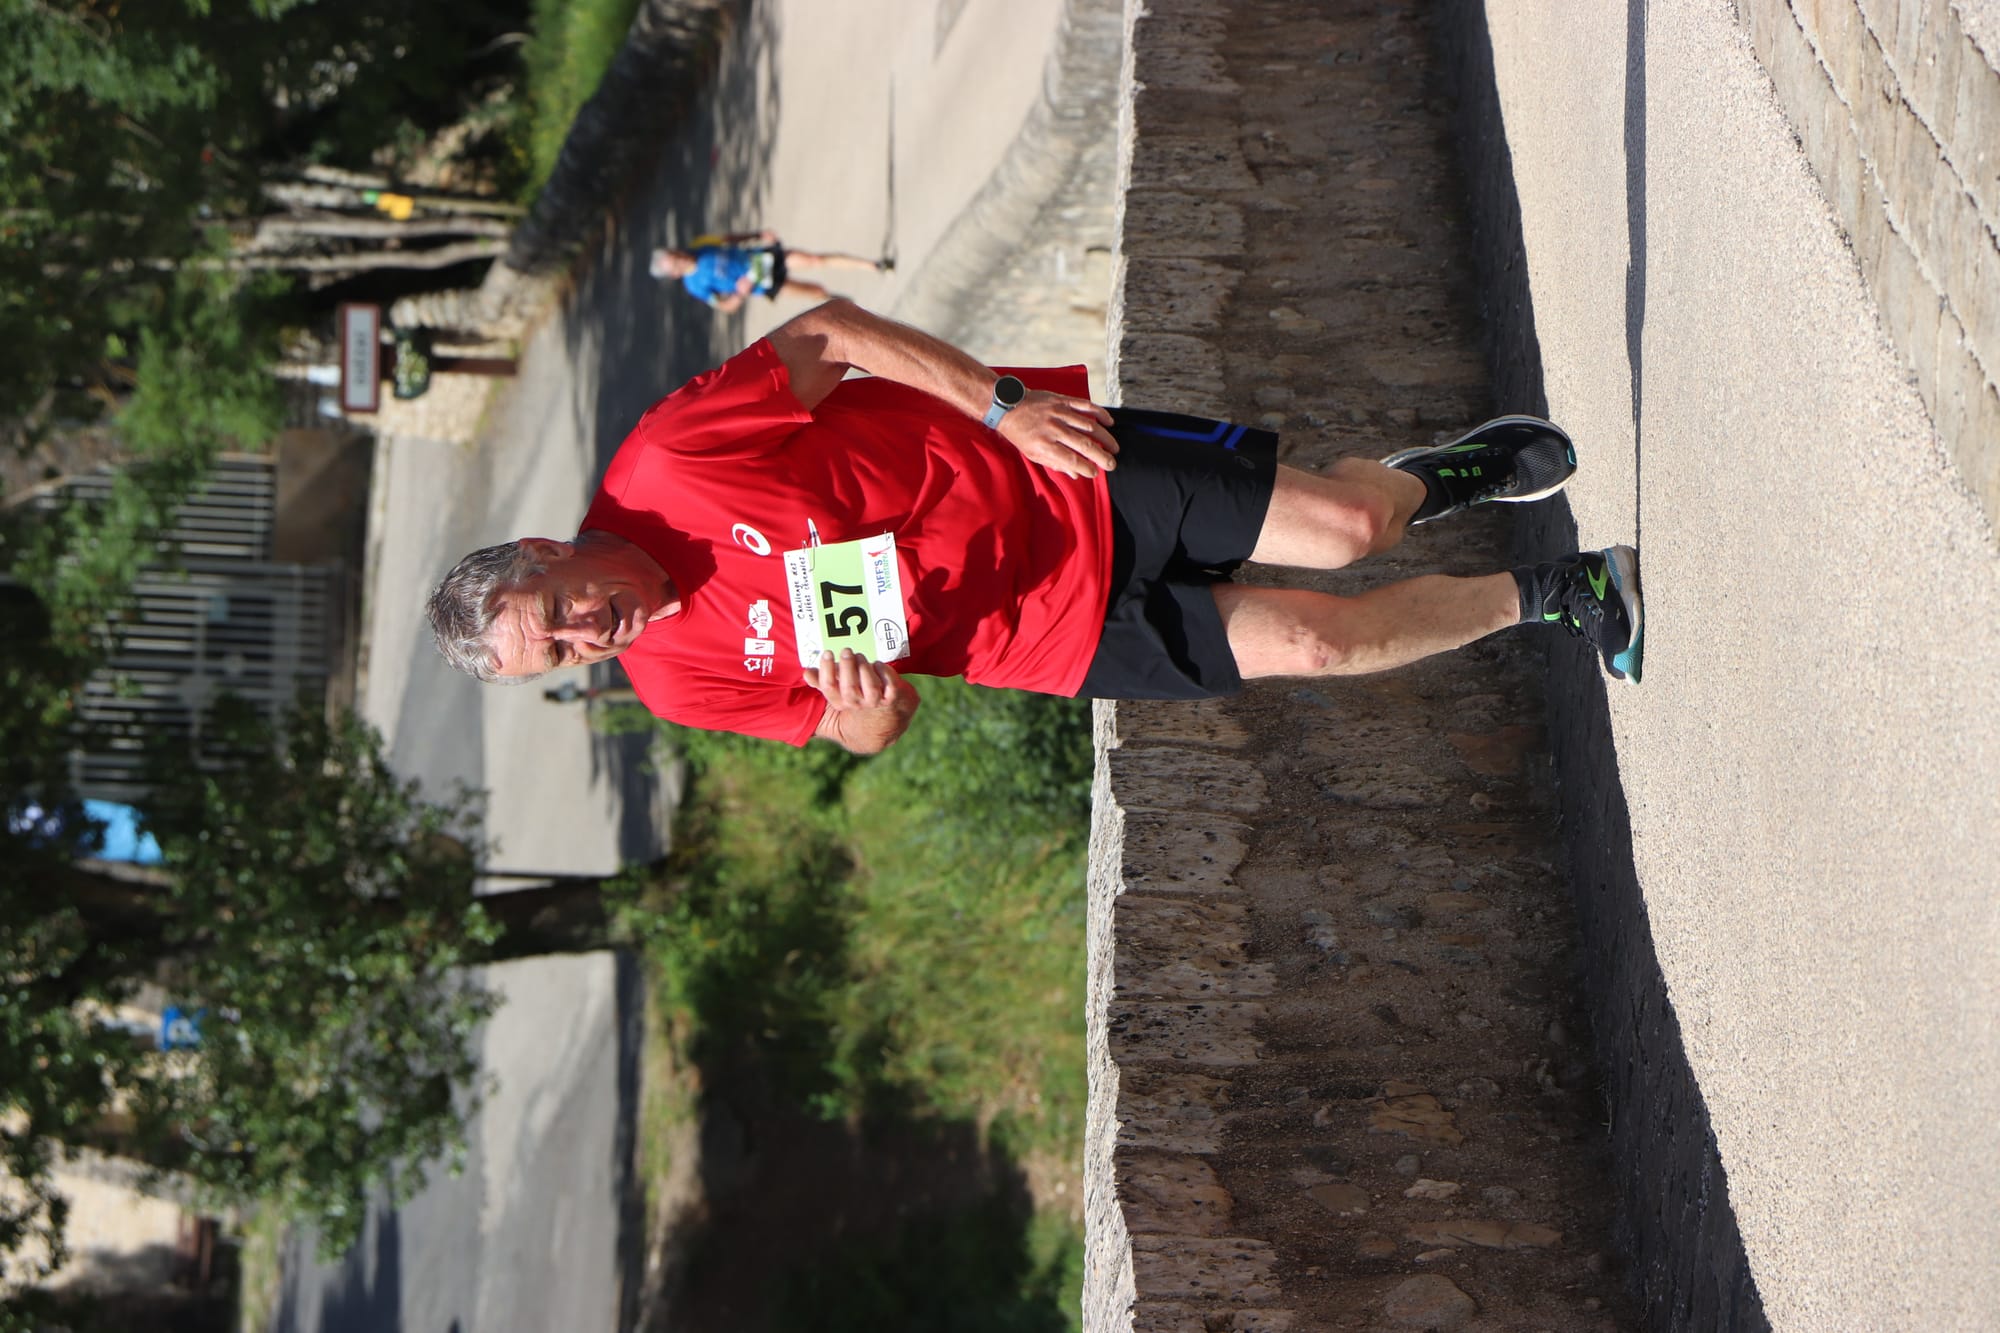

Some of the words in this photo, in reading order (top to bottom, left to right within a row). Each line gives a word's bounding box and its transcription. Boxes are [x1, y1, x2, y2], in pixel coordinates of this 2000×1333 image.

[790, 562, 798, 576] des
[874, 559, 886, 595] TUFF'S
[794, 581, 805, 620] Challenge
[820, 581, 868, 638] 57
[883, 622, 896, 651] BFP
